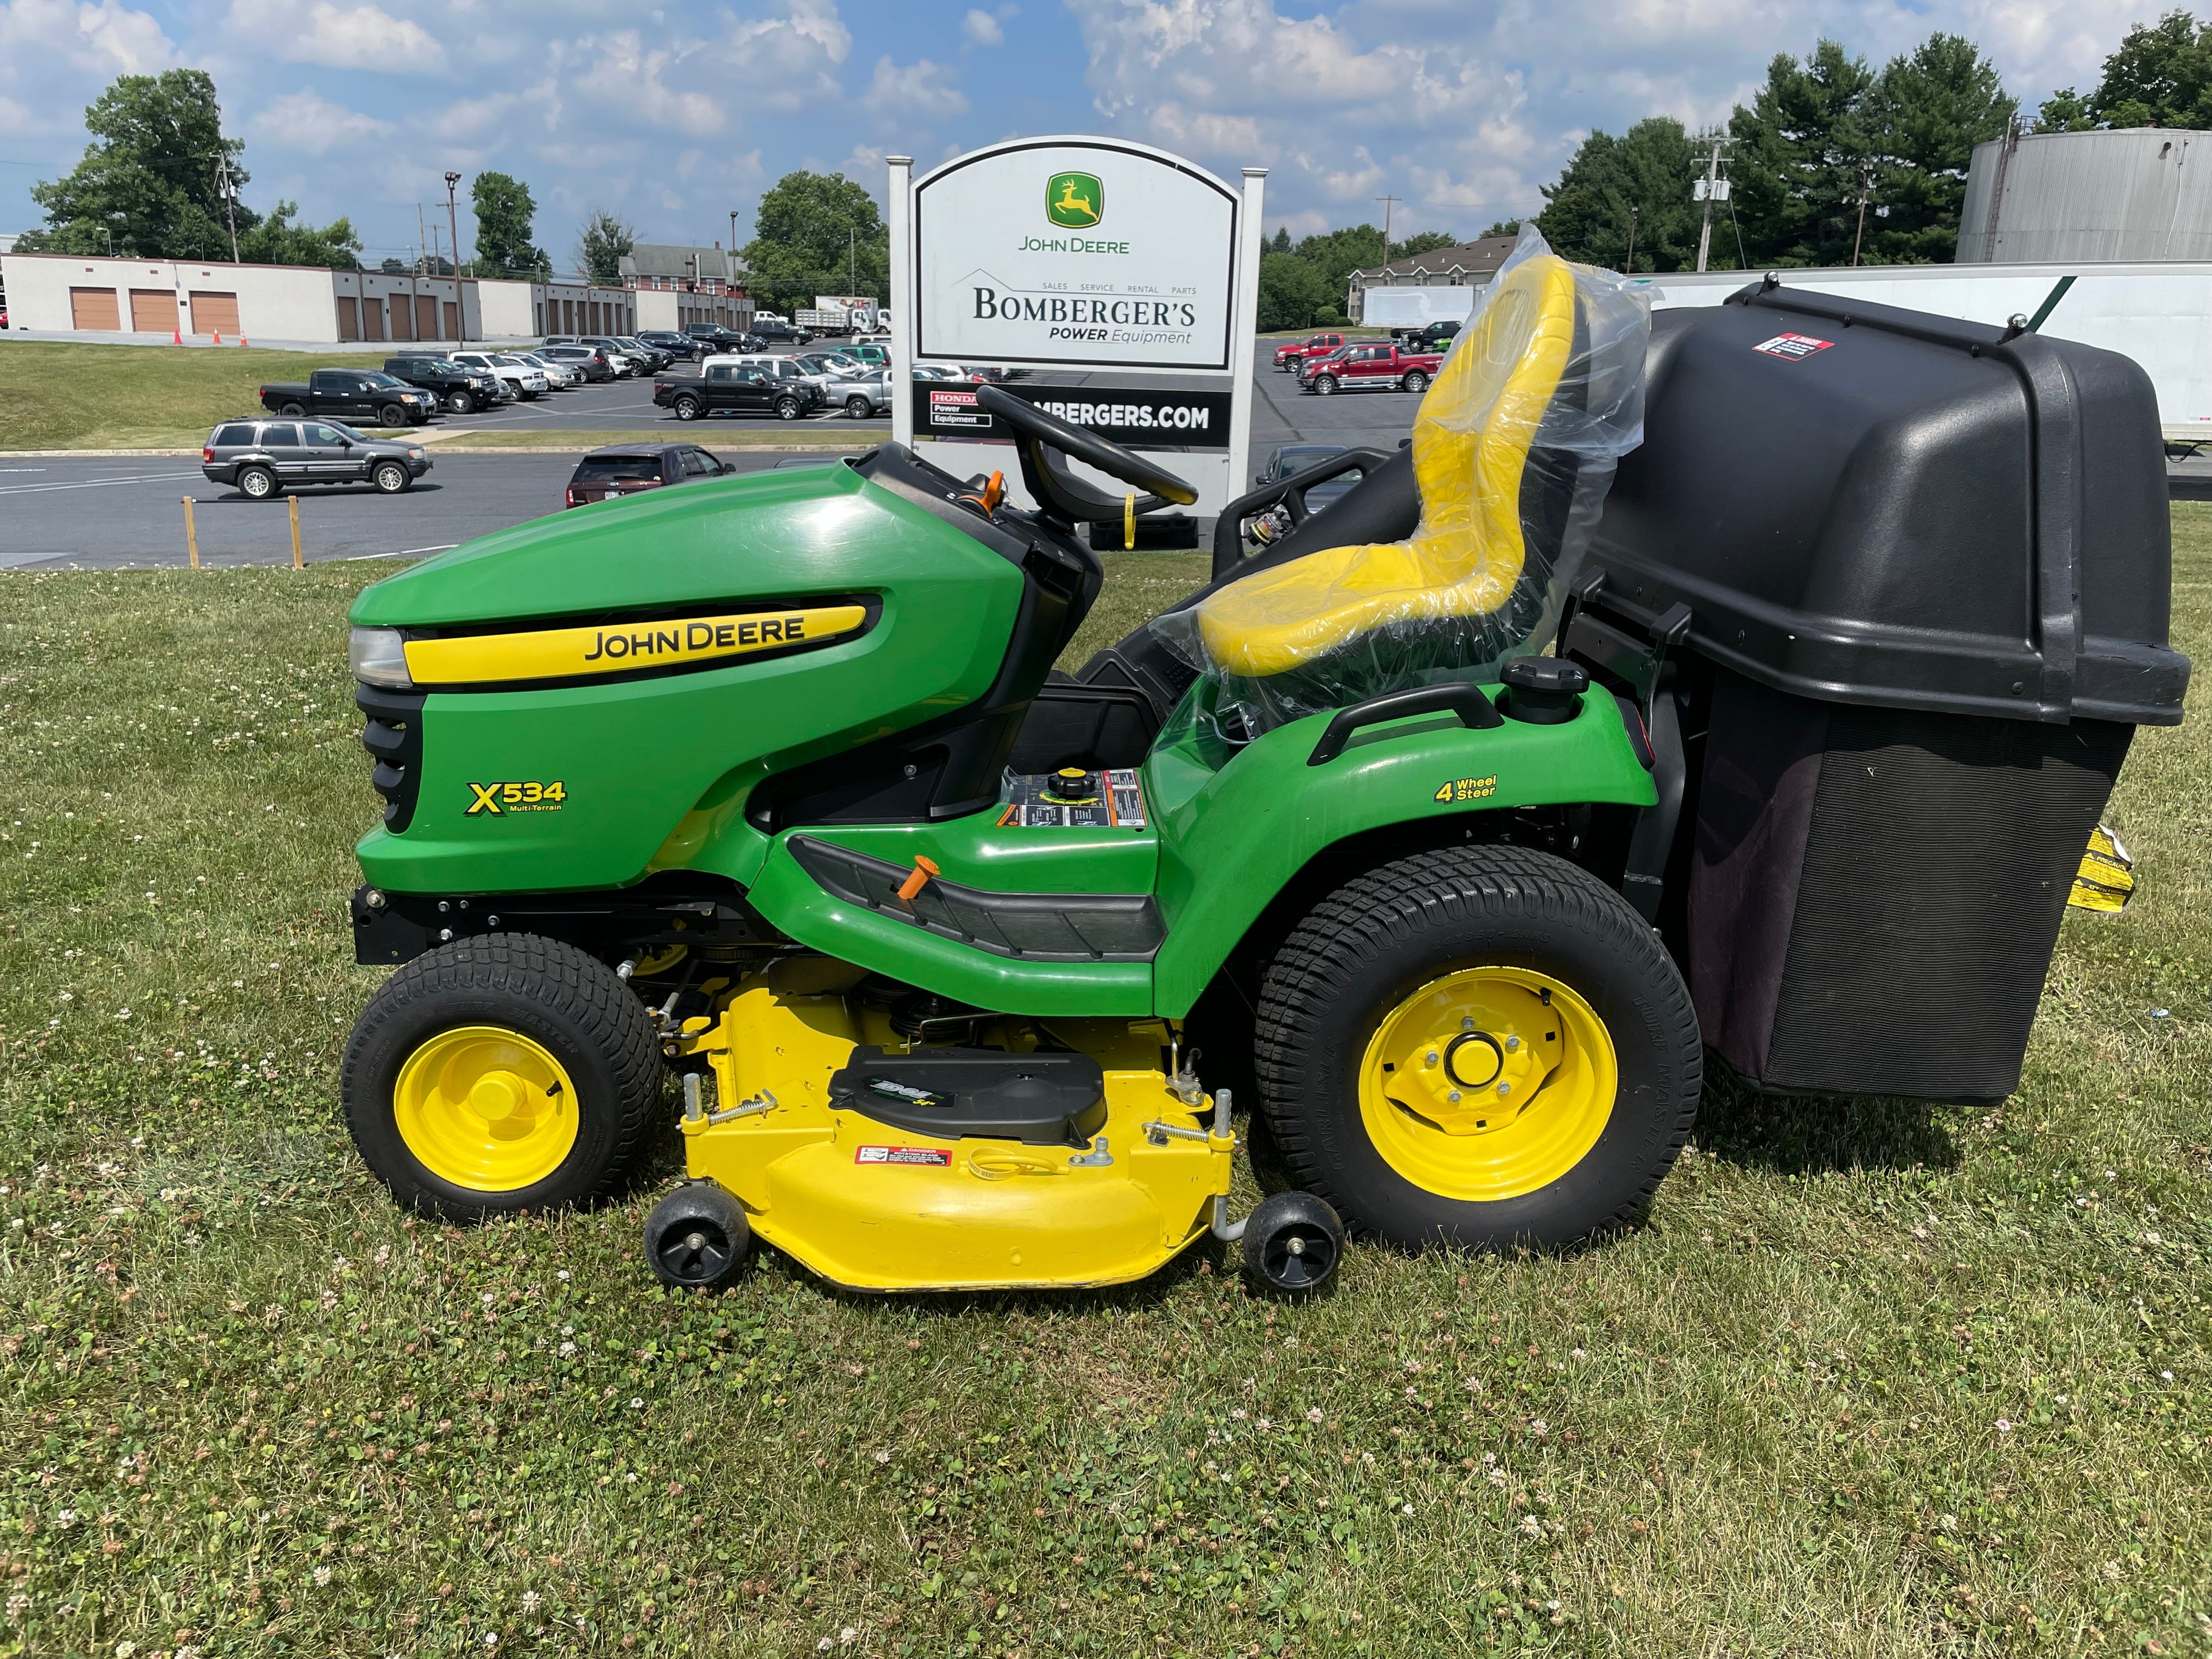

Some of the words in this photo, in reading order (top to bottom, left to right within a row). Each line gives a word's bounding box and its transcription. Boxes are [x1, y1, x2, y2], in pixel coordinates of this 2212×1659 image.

[1018, 236, 1067, 252] JOHN
[1070, 237, 1130, 254] DEERE
[1042, 282, 1067, 290] SALES
[1080, 283, 1114, 292] SERVICE
[1127, 285, 1158, 293] RENTAL
[1172, 286, 1197, 295] PARTS
[973, 287, 1195, 327] BOMBERGER'S
[1049, 327, 1108, 341] POWER
[1111, 329, 1192, 345] Equipment
[934, 395, 977, 403] HONDA
[934, 404, 961, 412] Power
[934, 415, 978, 423] Equipment
[1033, 402, 1209, 429] MBERGERS.COM
[584, 630, 680, 660] JOHN
[686, 616, 805, 650] DEERE
[463, 781, 567, 815] X534
[1435, 781, 1454, 802] 4
[1456, 774, 1497, 790] Wheel
[1456, 786, 1496, 801] Steer
[509, 804, 562, 812] Multi-Terrain
[447, 1001, 497, 1015] TURF
[508, 1006, 578, 1055] MASTER
[1632, 993, 1669, 1052] TURF
[1316, 1039, 1342, 1171] CARLISLE
[1628, 1064, 1672, 1173] MASTER
